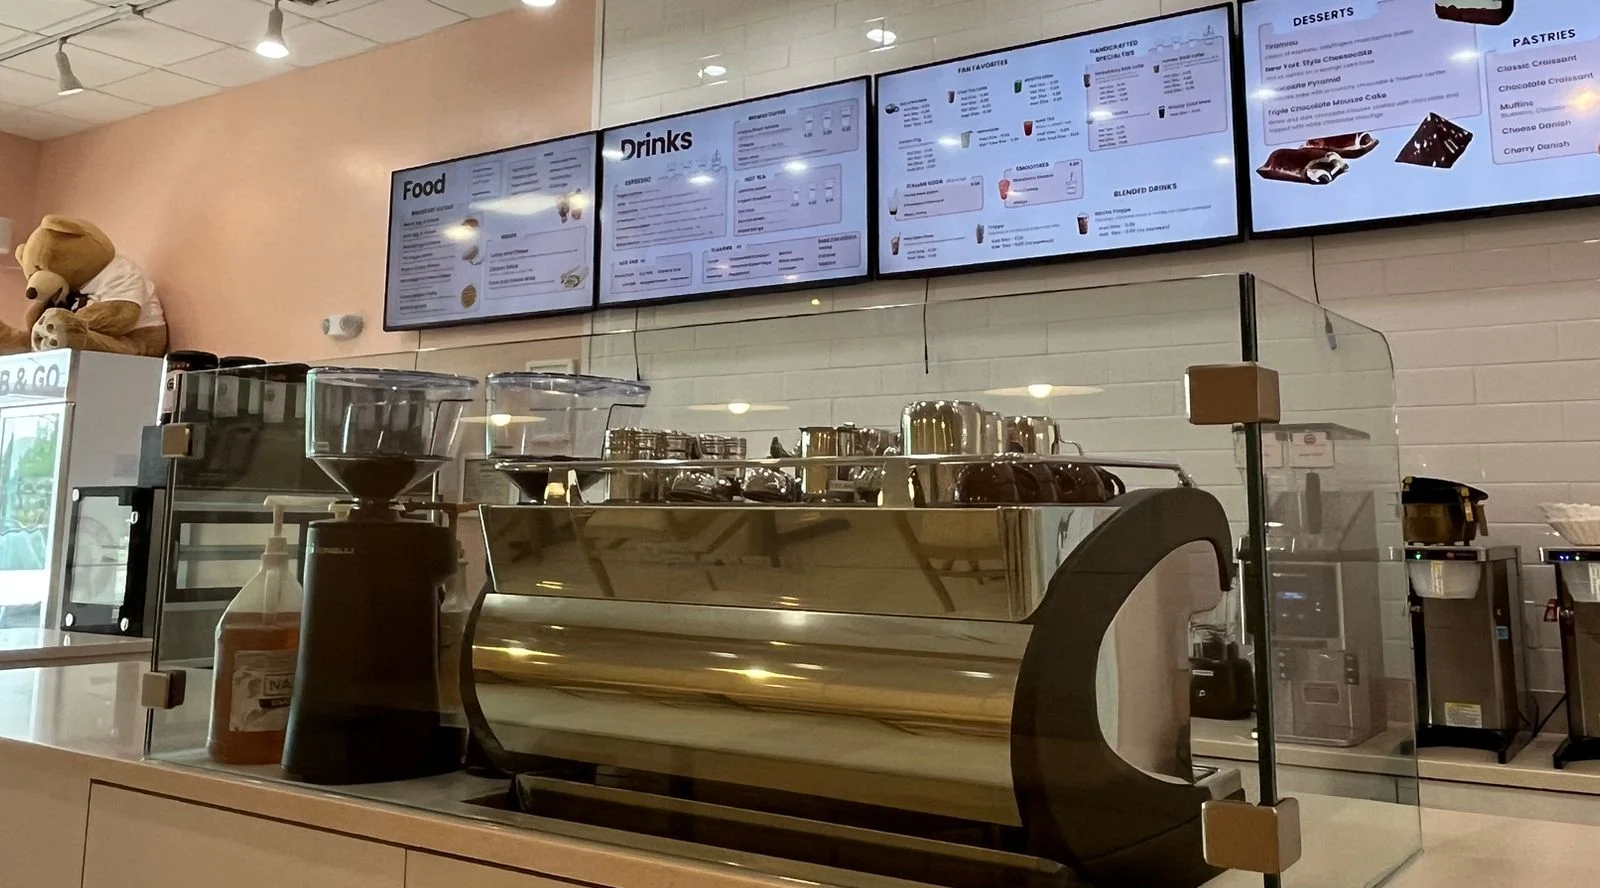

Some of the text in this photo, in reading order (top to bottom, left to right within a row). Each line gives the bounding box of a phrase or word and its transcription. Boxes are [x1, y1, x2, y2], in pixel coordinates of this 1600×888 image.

[1293, 7, 1354, 27] DESSERTS
[1090, 40, 1138, 54] HANDCRAFTED
[1513, 29, 1576, 47] PASTRIES
[972, 59, 1008, 71] FAVORITES
[1265, 49, 1373, 73] New York Style Cheesecake
[1497, 55, 1577, 73] Classic Croissant
[1308, 75, 1341, 88] Pyramid
[1499, 72, 1594, 92] Chocolate Croissant
[1268, 91, 1387, 116] Triple Chocolate Mousse Cake
[1500, 100, 1534, 110] Muffins
[1502, 119, 1572, 135] Cheese Danish
[621, 129, 693, 161] Drinks
[1504, 140, 1570, 155] Cherry Danish
[403, 173, 446, 200] Food
[1114, 182, 1177, 197] BLENDED DRINKS
[32, 363, 60, 391] GO
